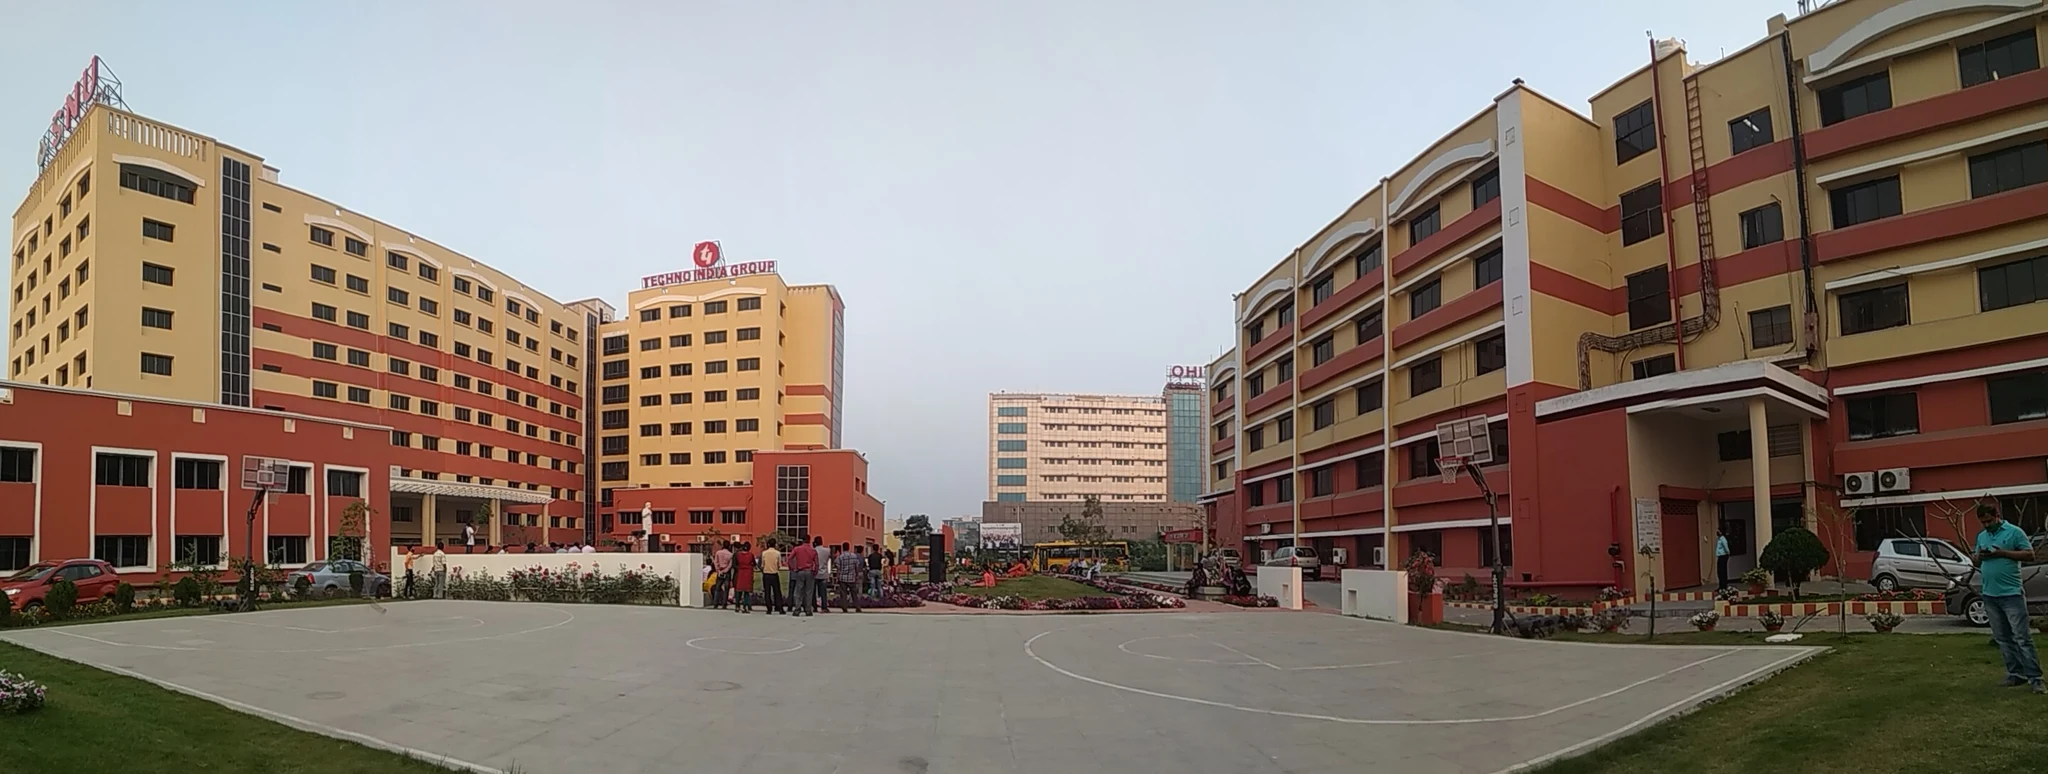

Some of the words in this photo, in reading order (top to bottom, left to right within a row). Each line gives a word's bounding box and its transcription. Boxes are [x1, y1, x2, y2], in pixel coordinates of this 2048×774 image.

[642, 271, 691, 288] TECHNO
[694, 266, 728, 282] INDIA
[730, 260, 776, 276] GROUP
